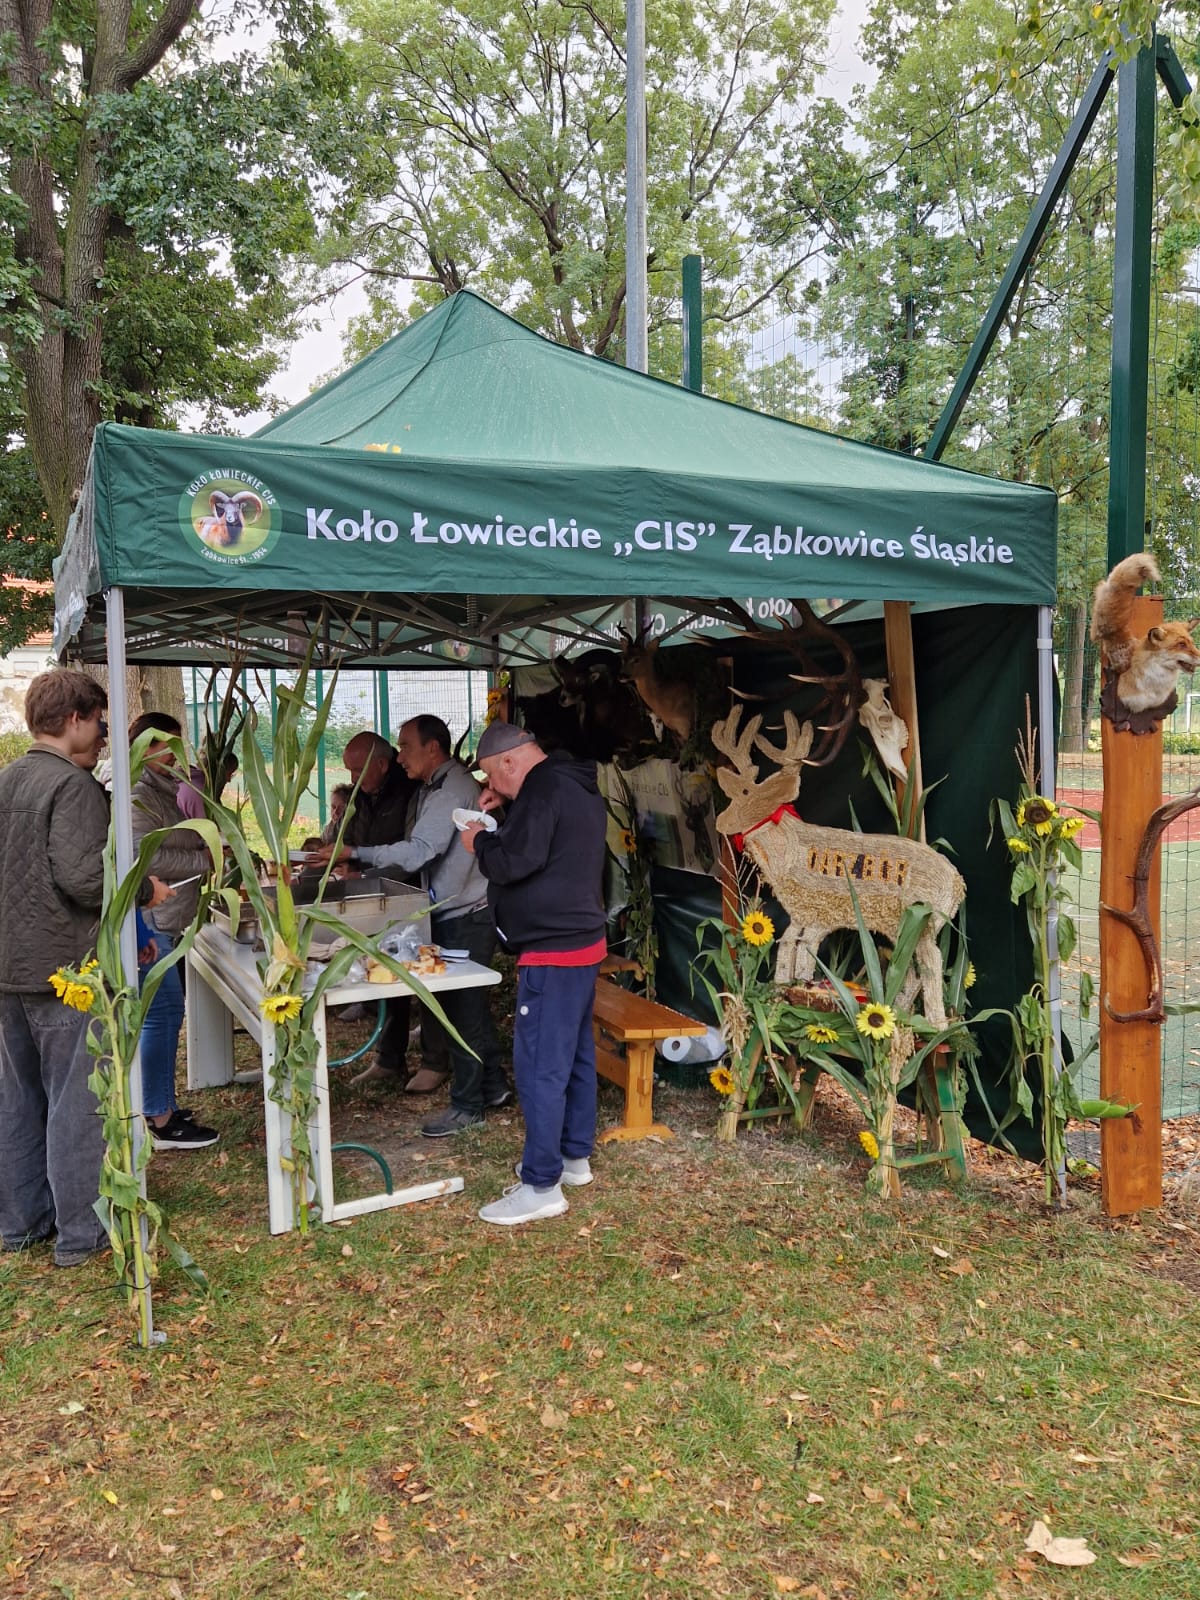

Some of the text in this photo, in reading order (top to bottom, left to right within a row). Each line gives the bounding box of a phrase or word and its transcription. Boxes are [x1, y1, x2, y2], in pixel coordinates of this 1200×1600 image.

[186, 469, 276, 505] KOŁO ŁOWIECKIE CIS
[306, 507, 399, 542] Koło
[410, 511, 601, 549] Łowieckie
[728, 523, 904, 561] Ząbkowice
[914, 526, 1014, 566] Śląskie
